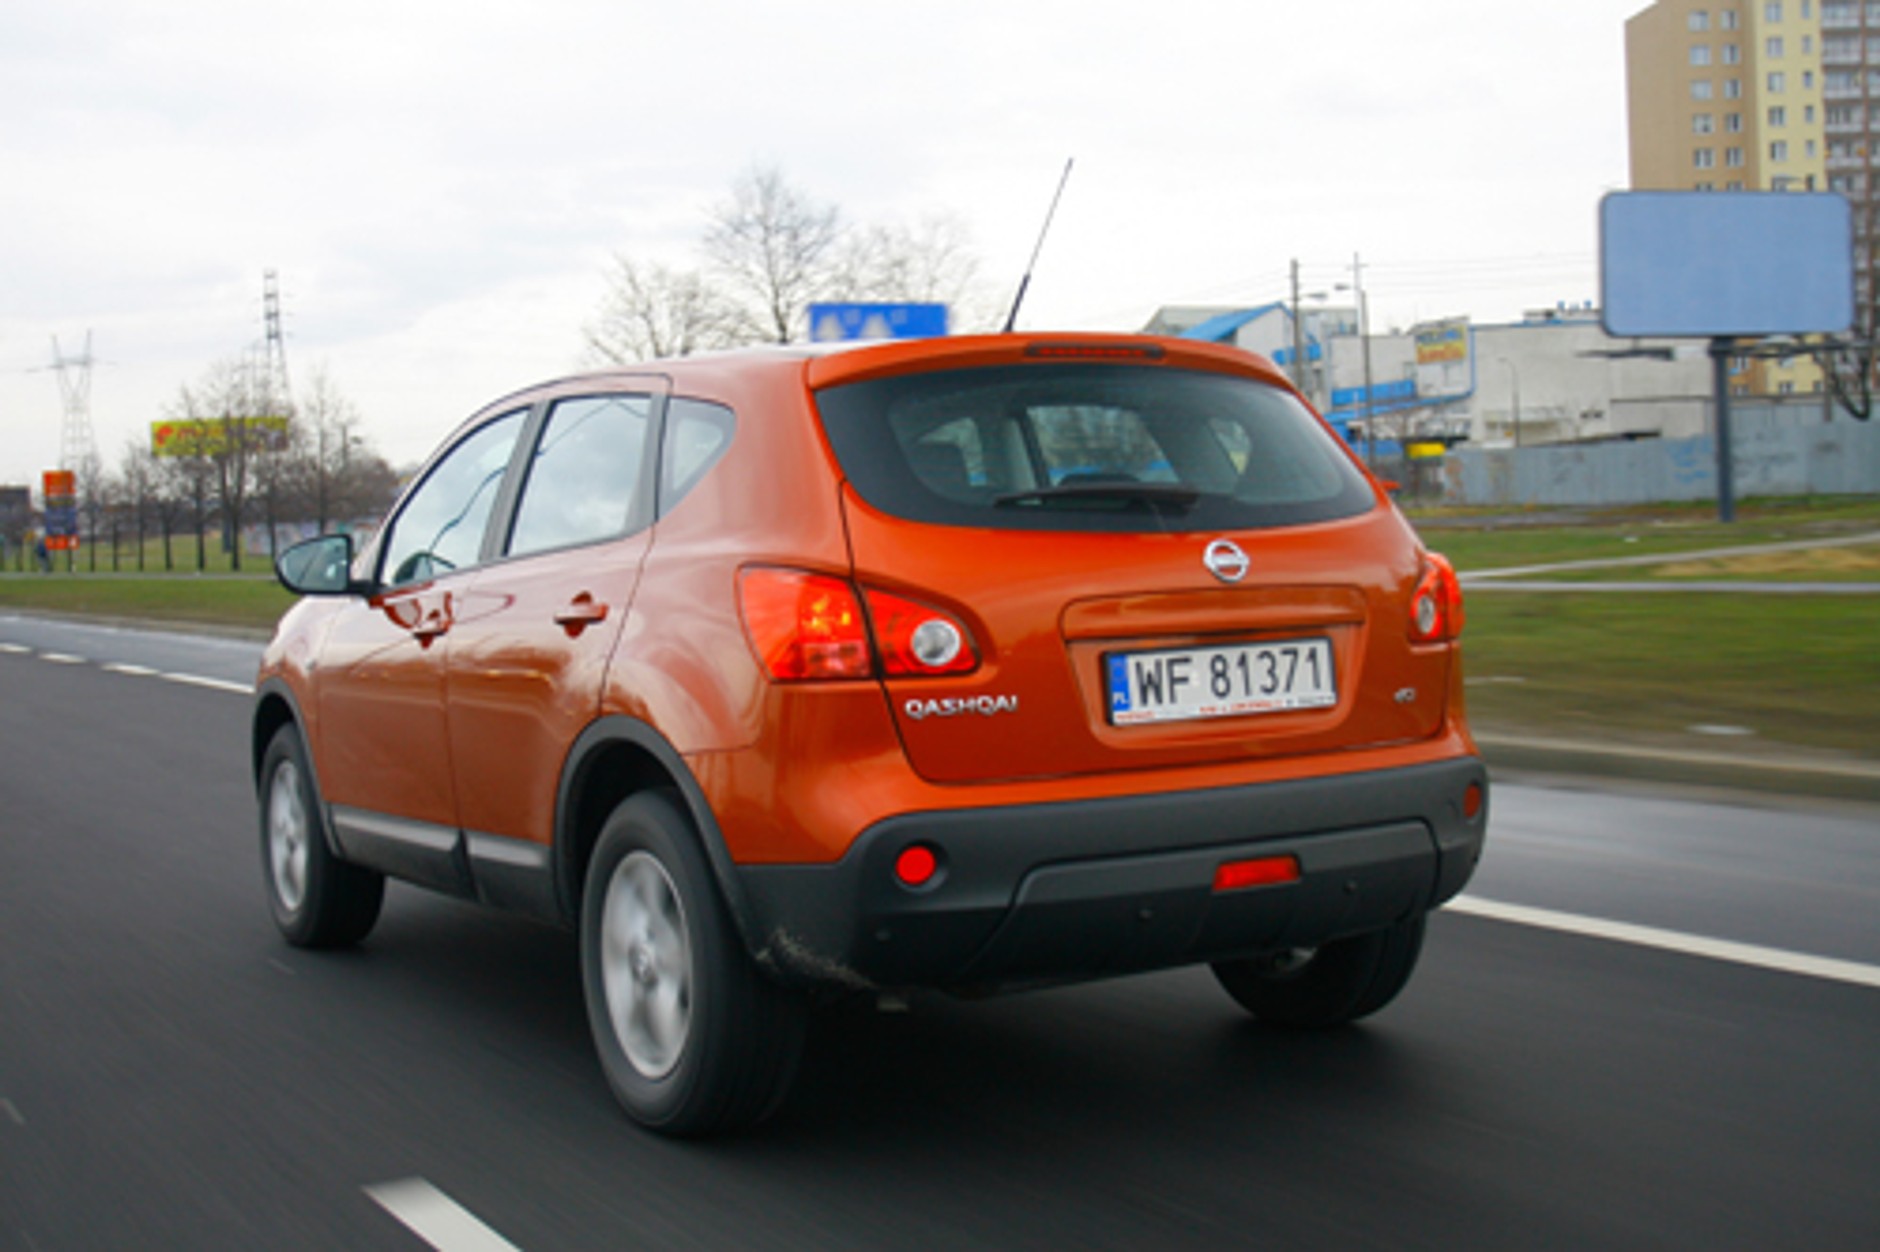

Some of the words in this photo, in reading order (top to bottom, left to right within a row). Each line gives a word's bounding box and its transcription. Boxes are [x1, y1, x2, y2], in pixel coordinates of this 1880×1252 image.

[1135, 657, 1192, 707] WF
[1209, 647, 1321, 698] 81371
[904, 694, 1018, 720] QASHQAI
